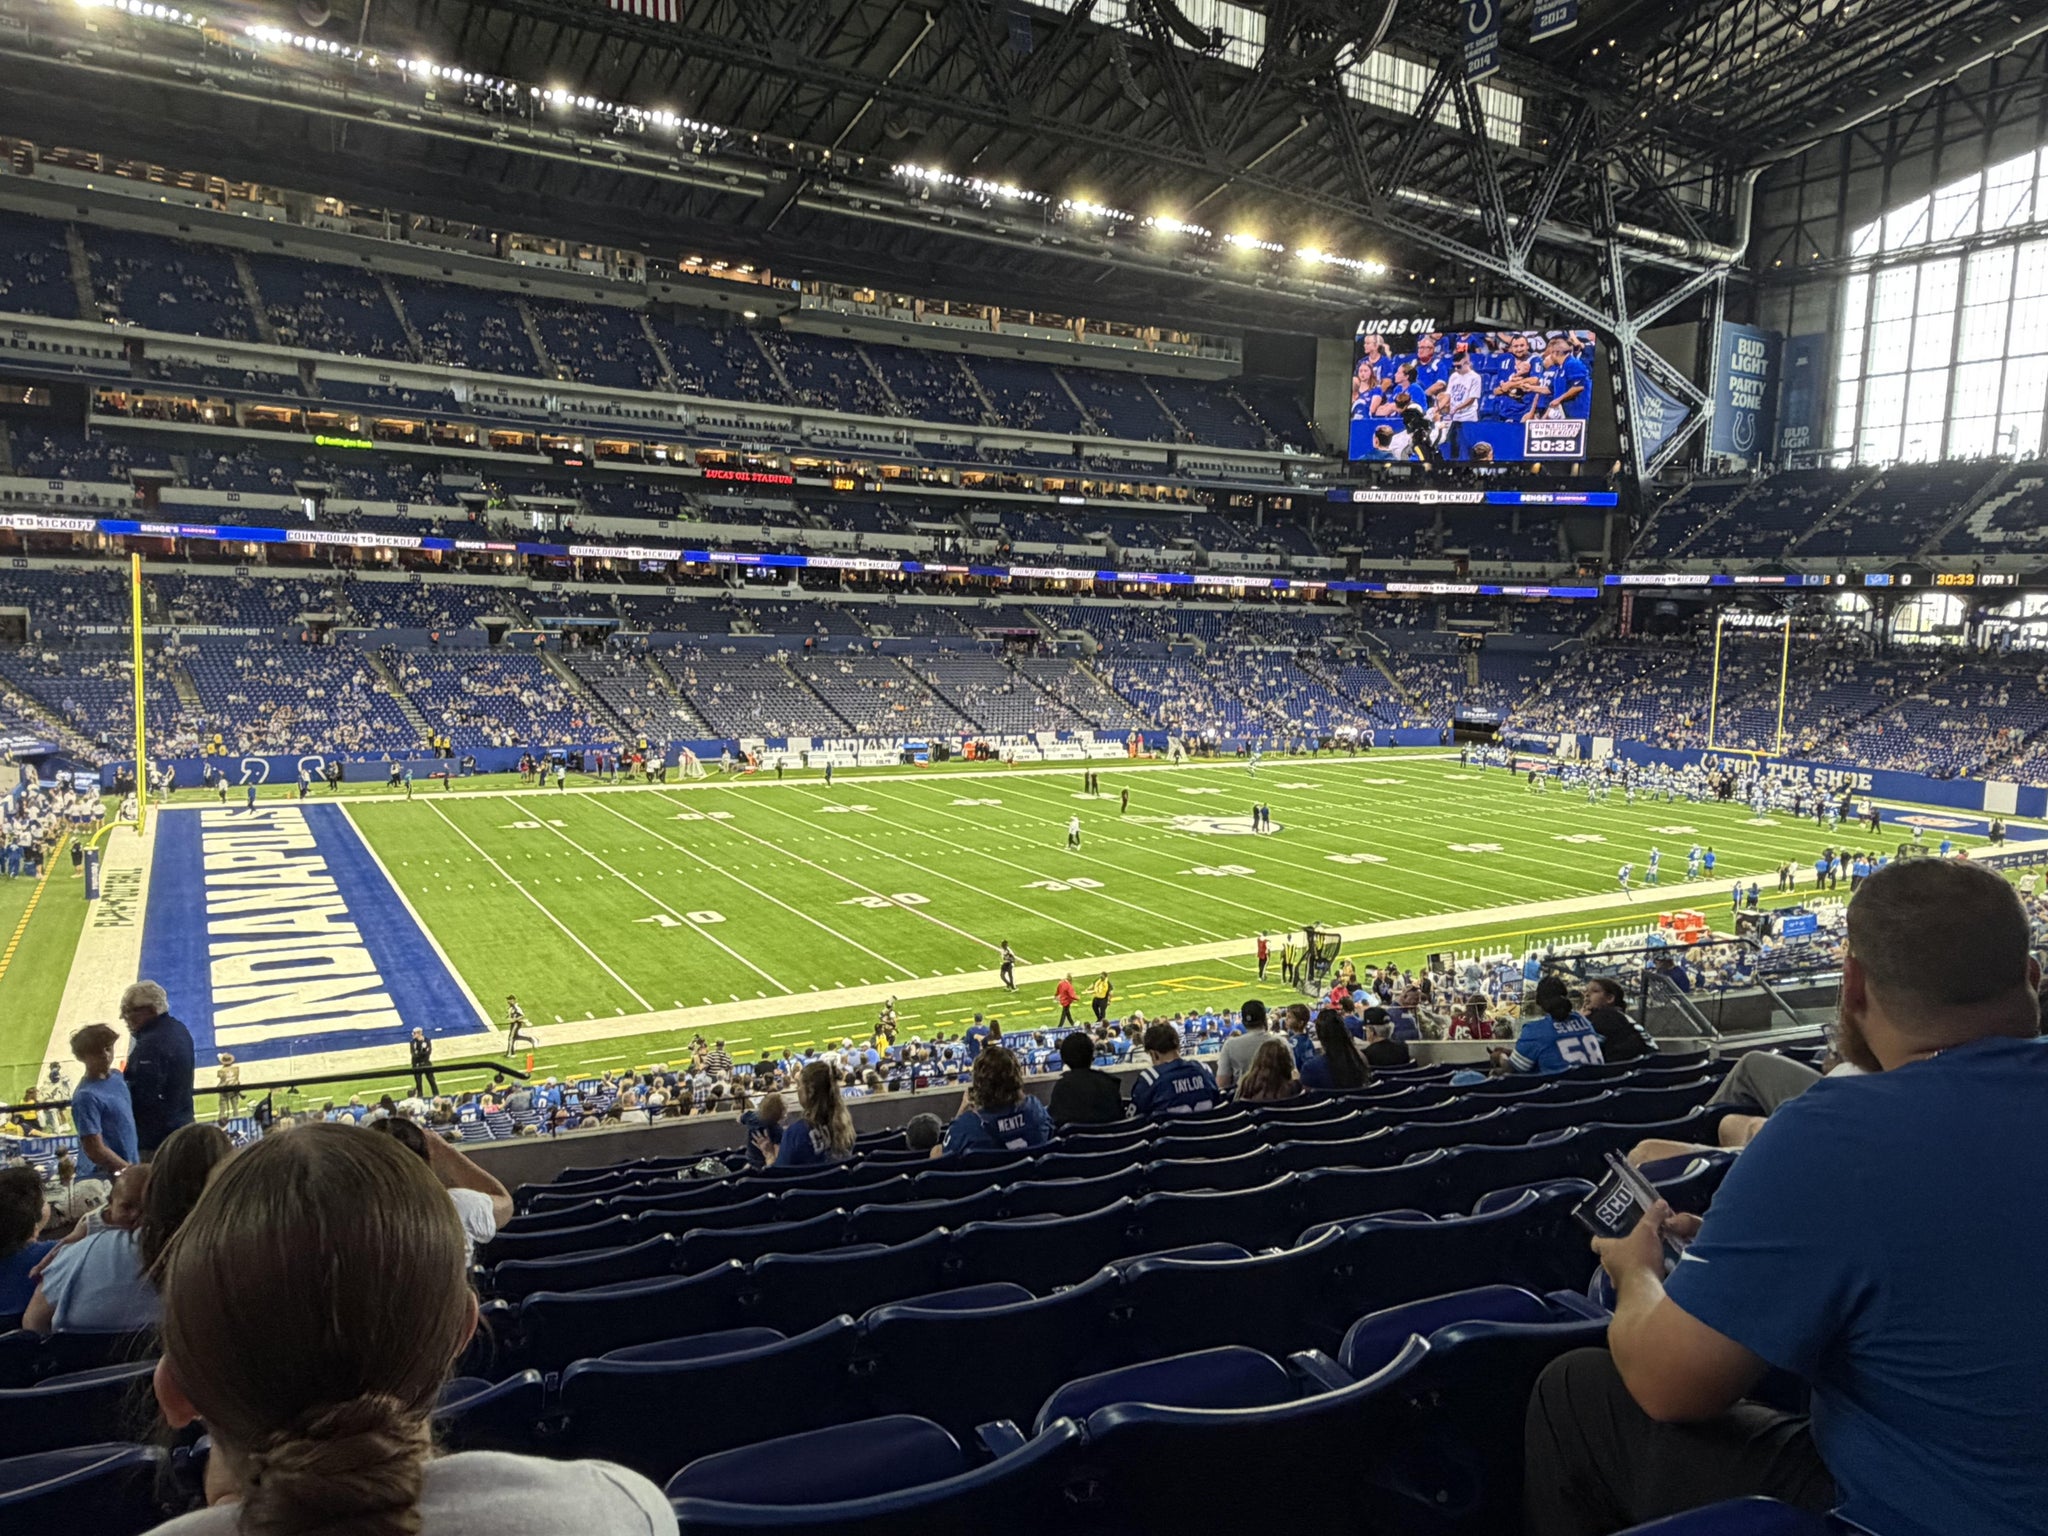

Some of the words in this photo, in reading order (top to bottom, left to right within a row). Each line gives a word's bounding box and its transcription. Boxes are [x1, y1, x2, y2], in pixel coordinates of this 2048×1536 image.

[1540, 7, 1568, 28] 2013
[1467, 53, 1492, 74] 2014
[1356, 319, 1409, 335] LUCAS
[1410, 318, 1436, 335] OIL
[1737, 338, 1765, 358] BUD
[1731, 353, 1768, 375] LIGHT
[1729, 376, 1766, 394] PARTY
[1731, 391, 1762, 410] ZONE
[1784, 427, 1809, 438] BUD
[1531, 440, 1575, 452] 30:33
[1781, 436, 1810, 449] LIGHT
[706, 470, 734, 480] LUCAS
[736, 473, 750, 481] OIL
[752, 474, 793, 484] STADIUM
[1354, 492, 1420, 501] COUNTDOWN
[1424, 493, 1436, 501] TO
[1437, 493, 1484, 502] KICKOFF
[17, 518, 34, 526] TO
[37, 519, 94, 530] KICKOFF
[287, 532, 358, 543] COUNTDOWN
[376, 537, 421, 547] KICKOFF
[570, 547, 629, 556] COUNTDOWN
[643, 551, 681, 560] KICKOFF
[1837, 574, 1846, 584] 0
[1902, 574, 1911, 584] 0
[1936, 574, 1975, 584] 30:33
[1982, 574, 2004, 584] QTR
[2007, 574, 2014, 584] 1
[1755, 615, 1774, 626] OIL
[1766, 762, 1810, 783] THE
[1813, 768, 1873, 791] SHOE
[852, 892, 931, 908] 20
[651, 910, 727, 927] 10
[201, 807, 404, 1047] INDIANAPOLIS
[1557, 1034, 1606, 1065] 58
[1172, 1076, 1205, 1094] TAYLOR
[997, 1114, 1026, 1132] WENTZ
